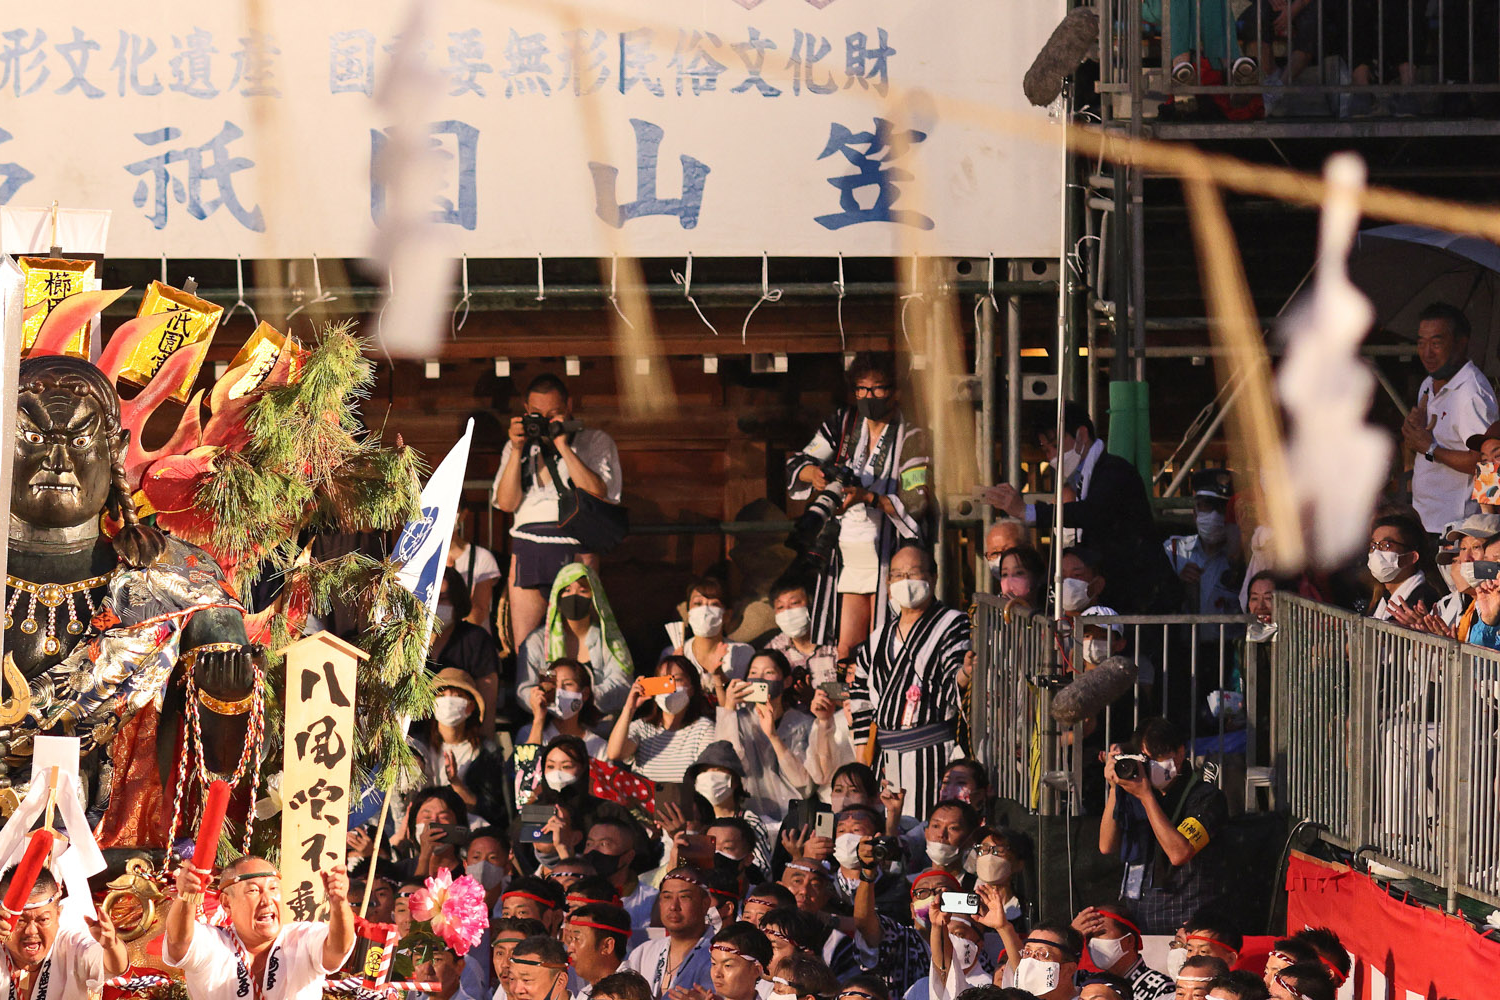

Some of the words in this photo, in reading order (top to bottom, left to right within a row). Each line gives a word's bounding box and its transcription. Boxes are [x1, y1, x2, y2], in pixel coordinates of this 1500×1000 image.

[328, 26, 897, 99] 国要無形民俗文化財
